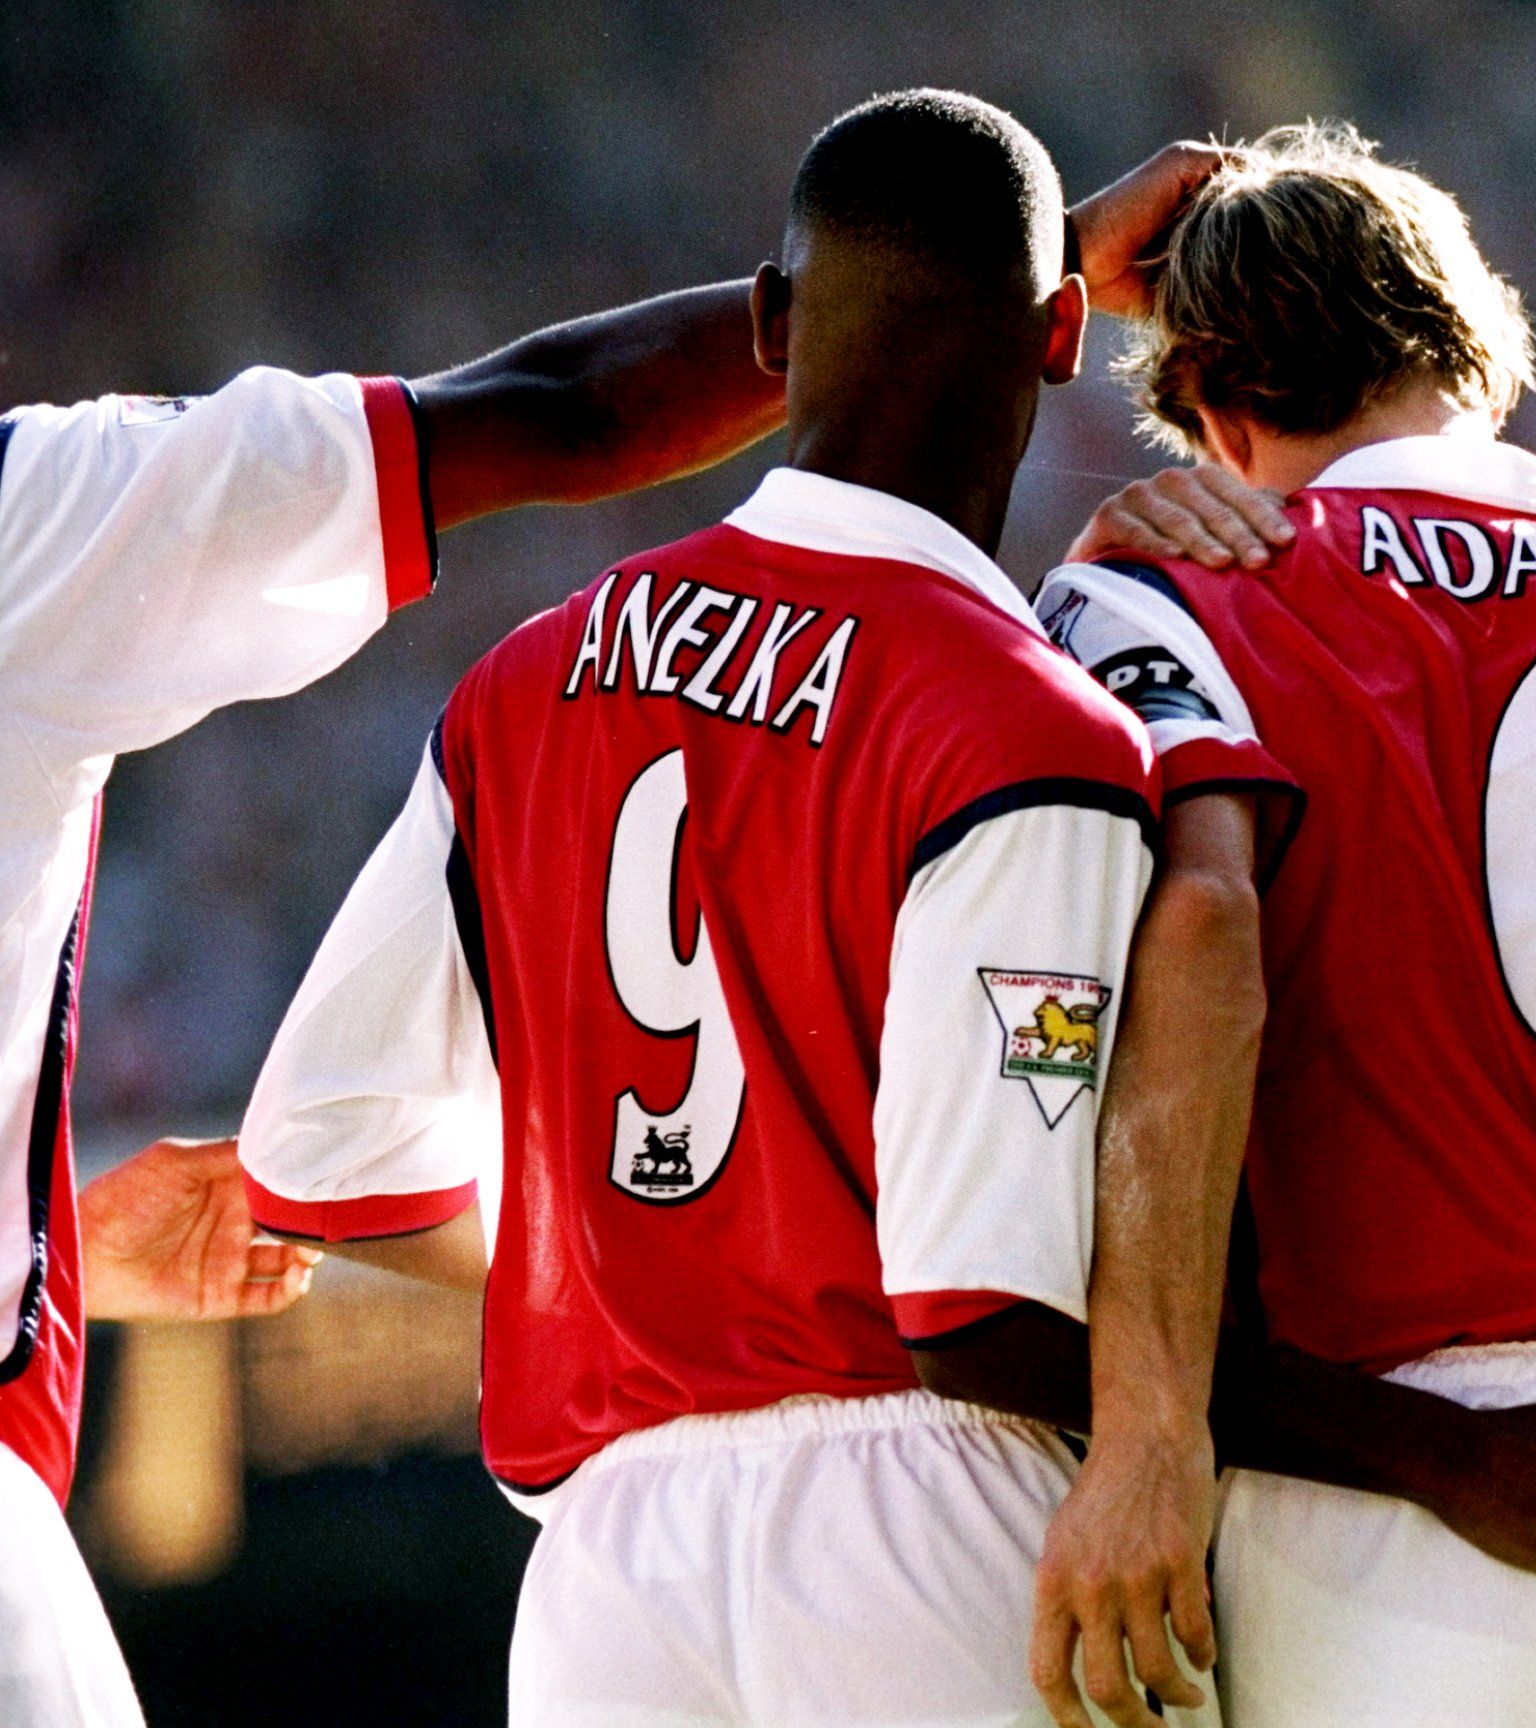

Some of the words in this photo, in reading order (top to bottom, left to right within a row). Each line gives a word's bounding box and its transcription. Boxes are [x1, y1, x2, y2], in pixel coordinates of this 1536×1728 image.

[563, 571, 860, 748] ANELKA
[606, 746, 746, 1206] 9
[990, 973, 1075, 991] CHAMPIONS
